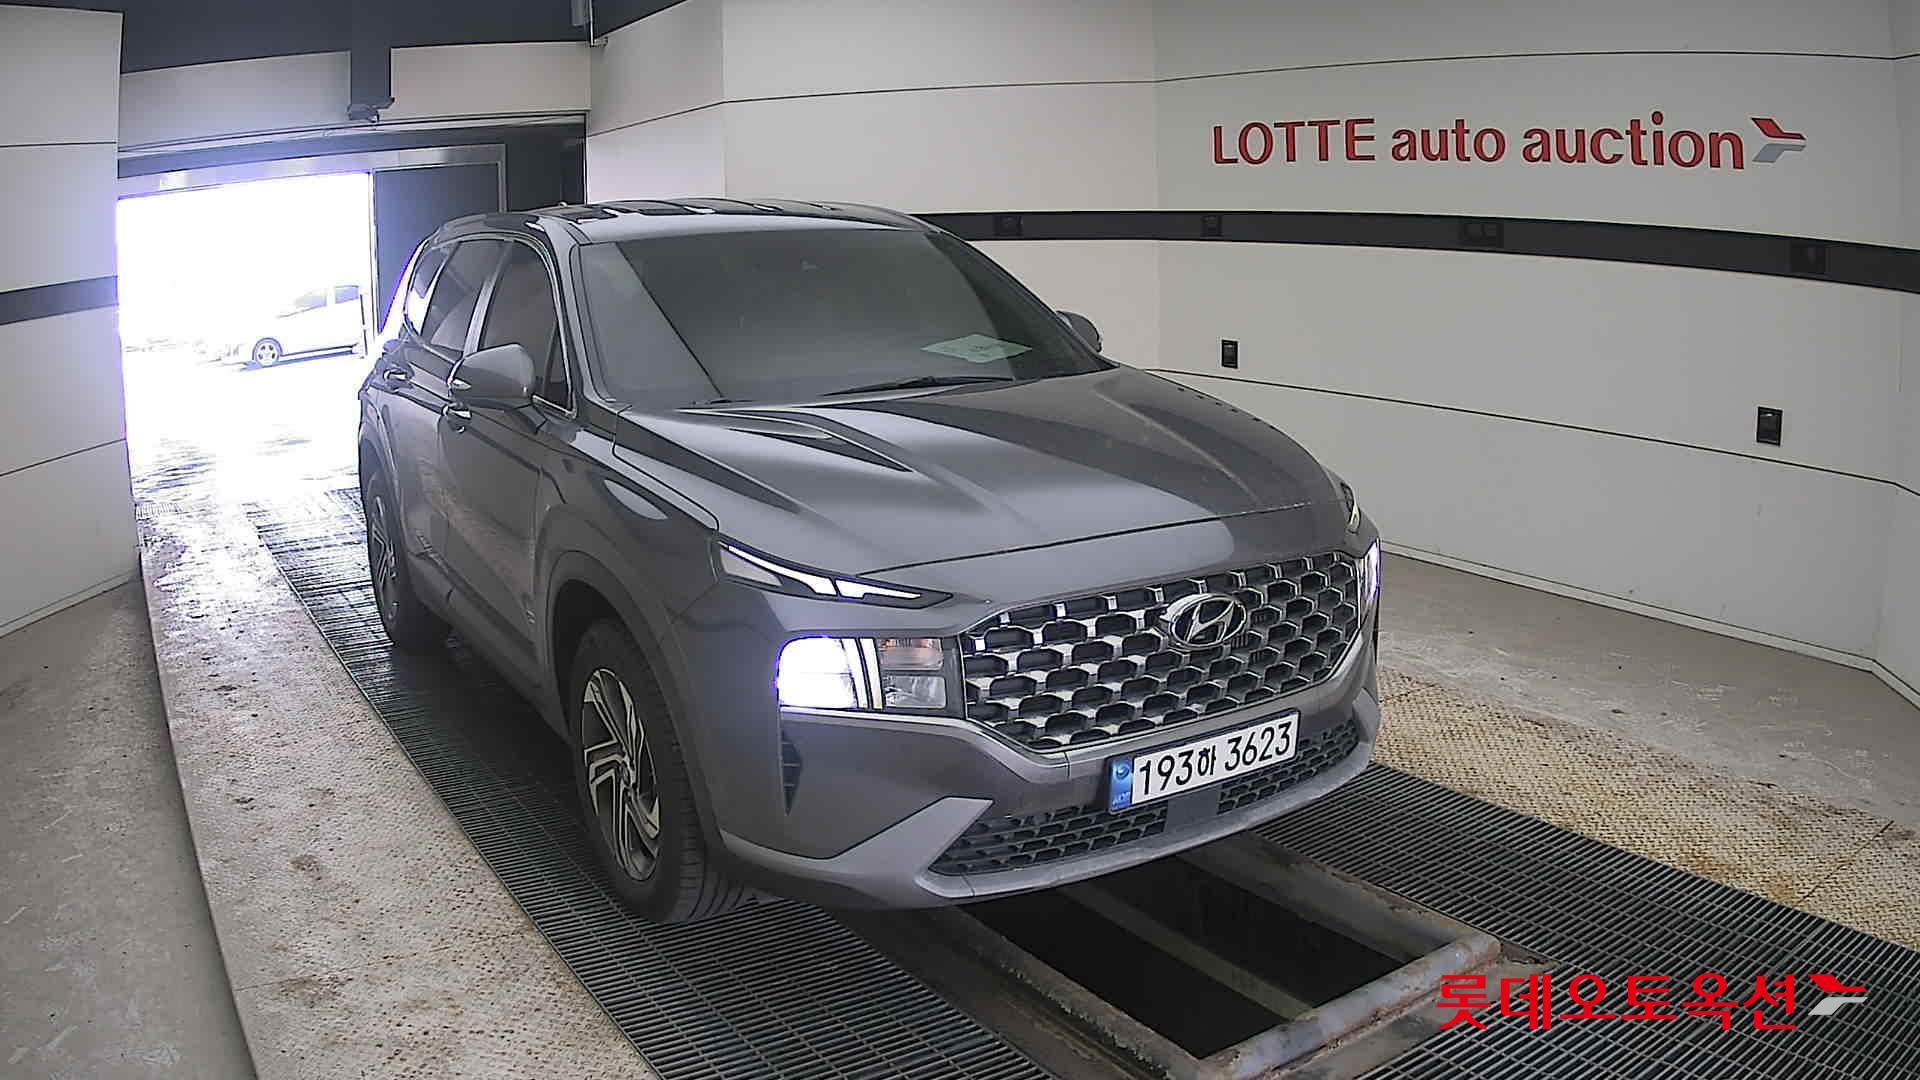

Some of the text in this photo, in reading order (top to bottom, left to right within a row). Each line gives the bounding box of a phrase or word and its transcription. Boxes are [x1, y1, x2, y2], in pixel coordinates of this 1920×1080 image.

[1213, 111, 1745, 170] LOTTE auto auction
[1139, 721, 1293, 796] 193하 3623
